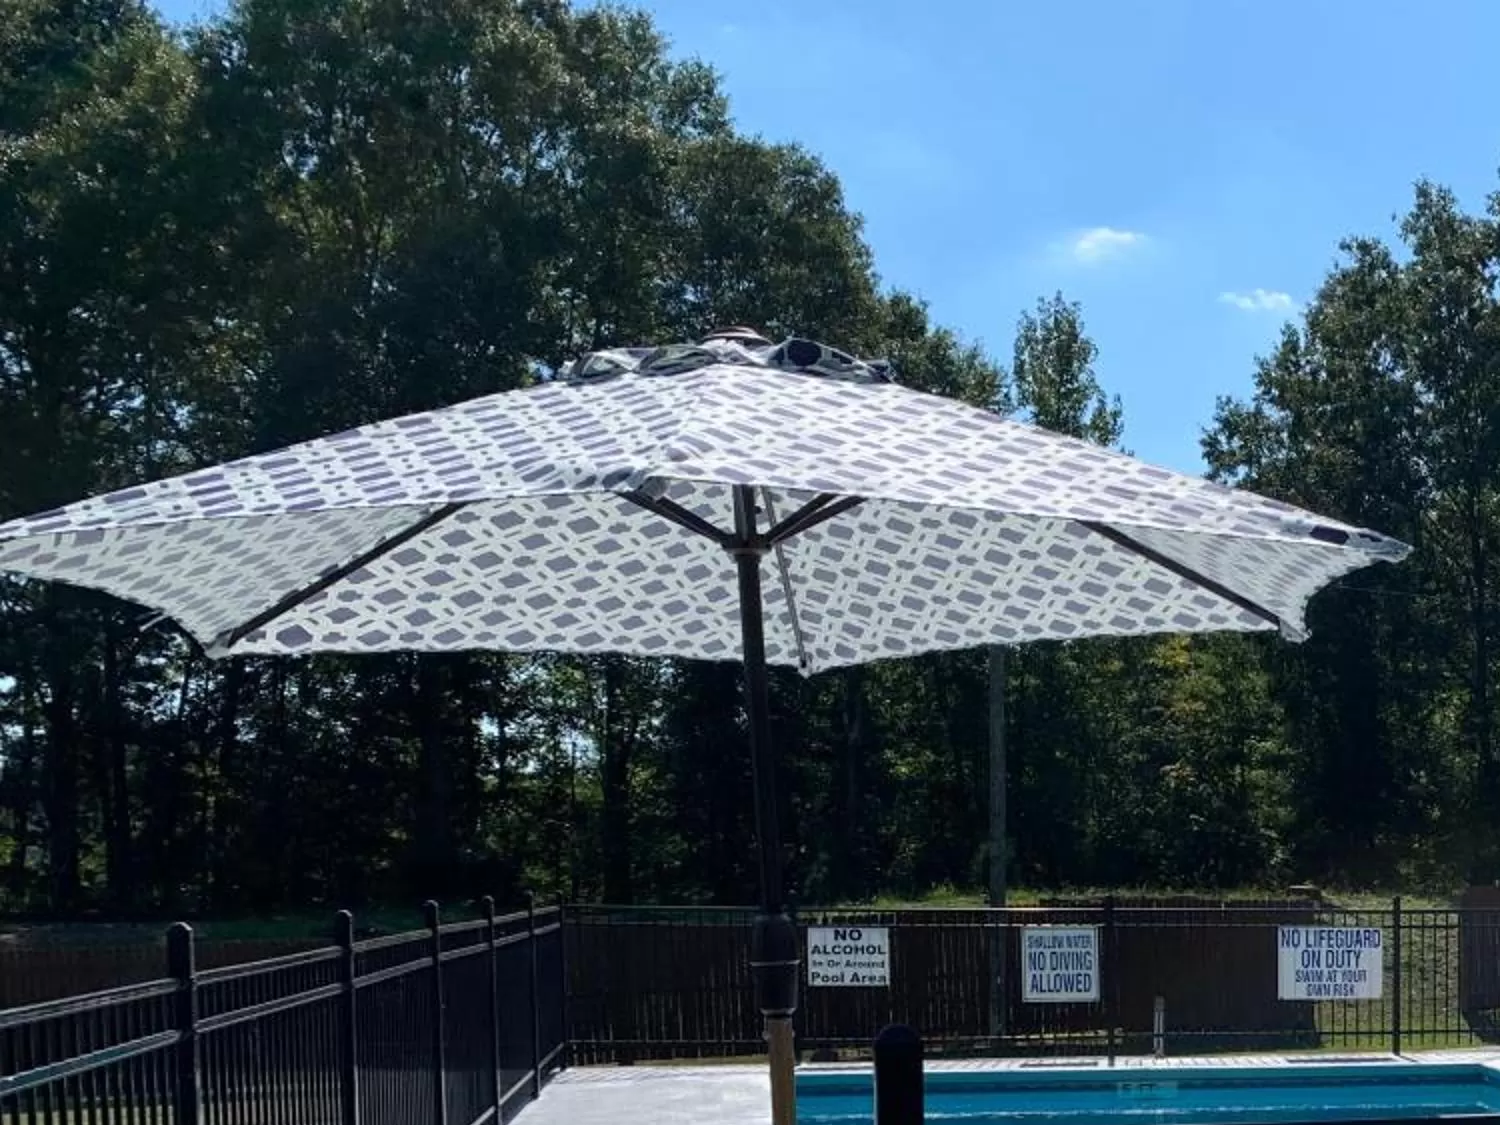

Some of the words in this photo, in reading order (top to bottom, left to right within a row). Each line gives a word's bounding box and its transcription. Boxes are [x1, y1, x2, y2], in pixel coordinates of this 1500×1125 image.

[833, 929, 863, 941] NO
[1281, 929, 1301, 948] NO
[1305, 929, 1381, 948] LIFEGUARD
[811, 944, 887, 955] ALCOHOL
[844, 959, 885, 968] Around
[1029, 951, 1046, 971] NO
[1050, 951, 1092, 971] DIVING
[1301, 949, 1321, 968] ON
[1325, 949, 1361, 968] DUTY
[811, 972, 845, 983] Pool
[850, 972, 887, 983] Area
[1030, 973, 1092, 993] ALLOWED
[1296, 970, 1323, 983] SWIM
[1326, 970, 1337, 983] AT
[1341, 970, 1367, 983] YOUR
[1307, 983, 1331, 996] OWN
[1333, 983, 1355, 996] RISK
